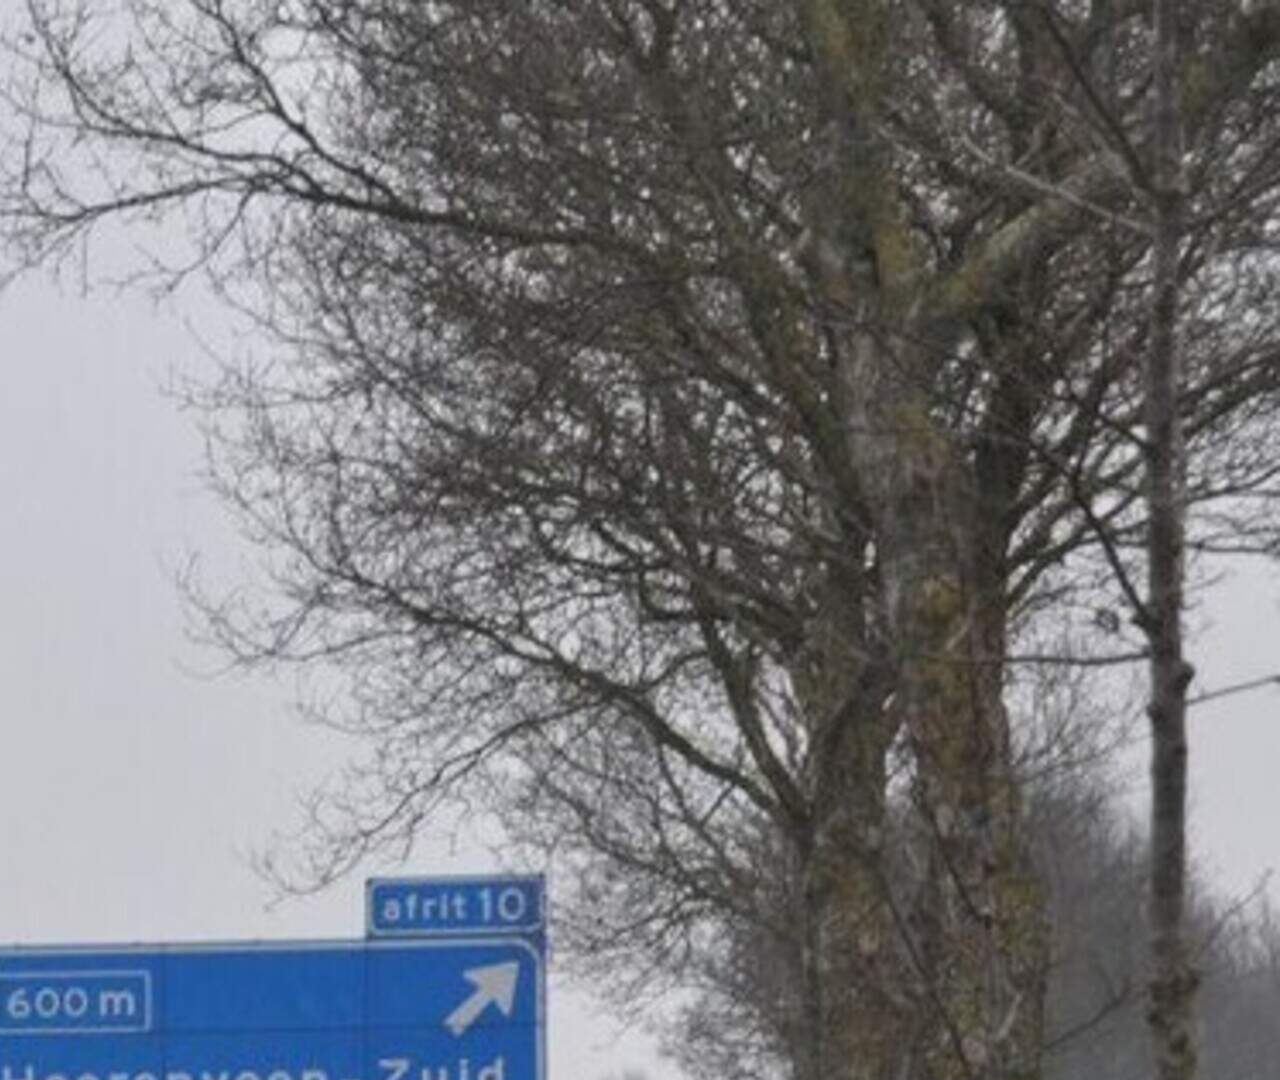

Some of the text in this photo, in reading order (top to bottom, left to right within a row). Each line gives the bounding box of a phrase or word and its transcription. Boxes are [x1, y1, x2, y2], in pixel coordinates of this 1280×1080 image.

[382, 887, 527, 922] afrit 10
[5, 987, 136, 1019] 600 m
